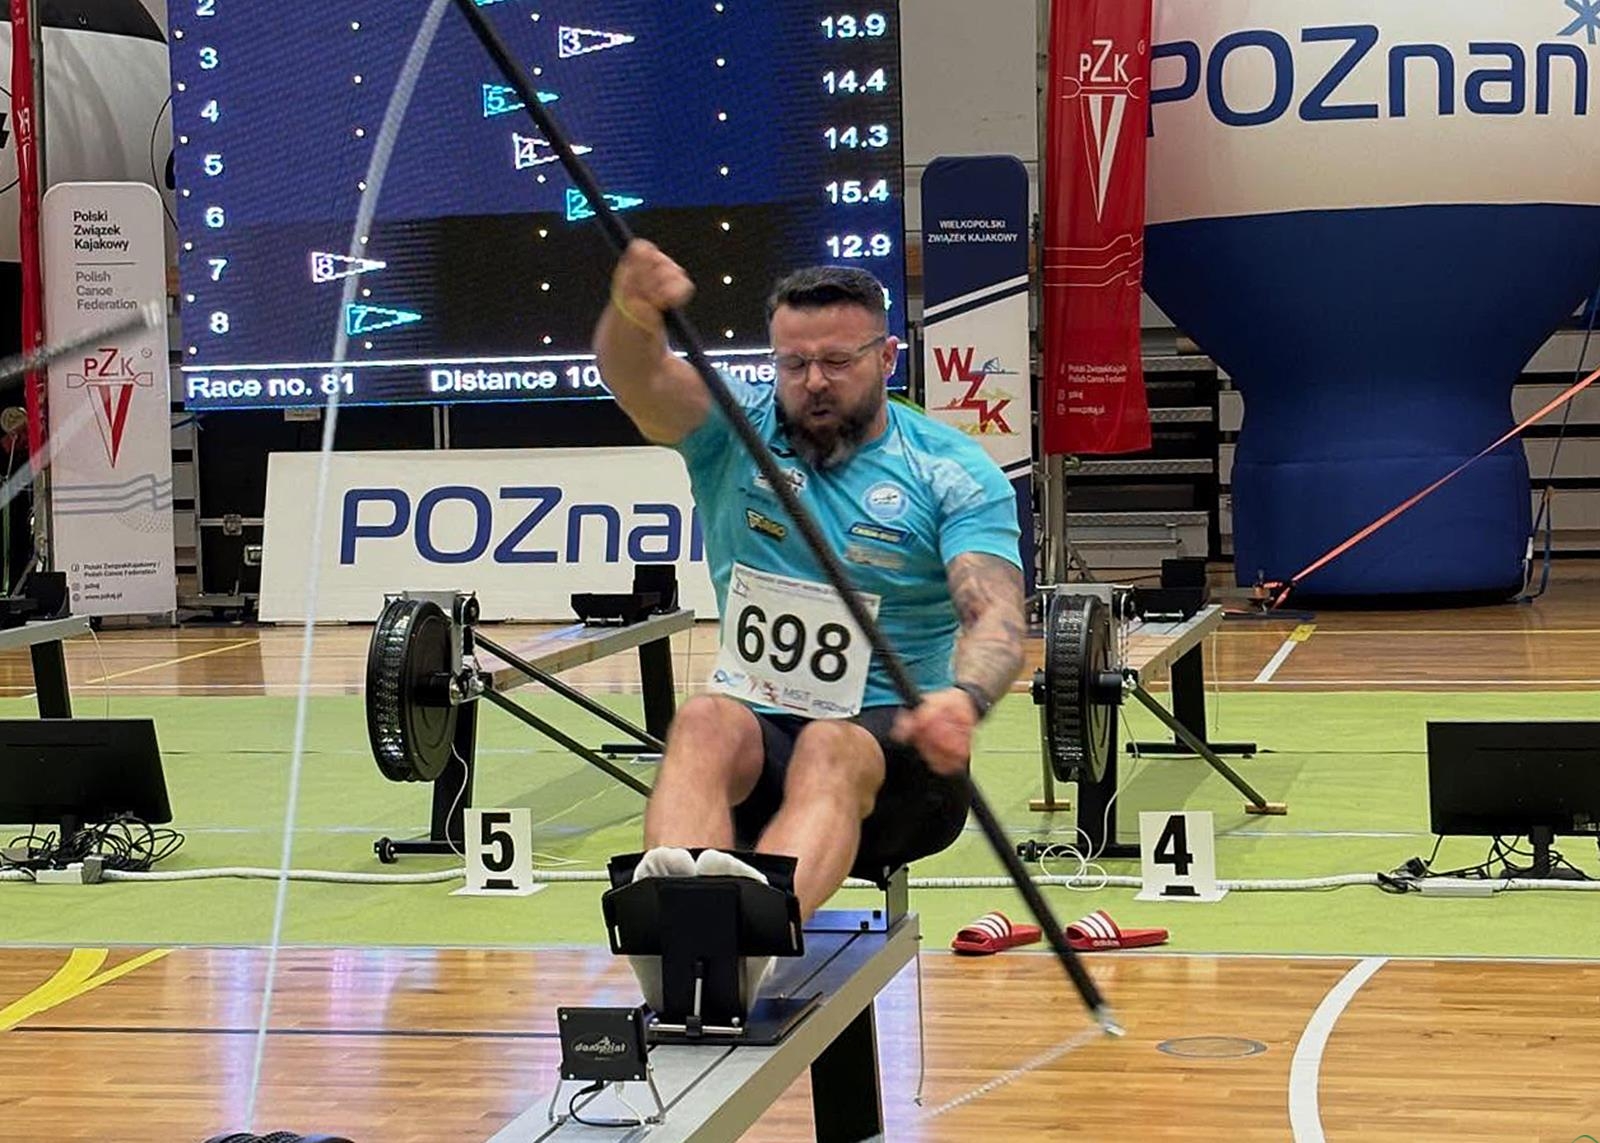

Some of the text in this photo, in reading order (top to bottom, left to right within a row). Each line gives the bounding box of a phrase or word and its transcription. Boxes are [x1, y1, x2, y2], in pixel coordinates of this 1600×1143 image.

[196, 0, 216, 16] 2
[821, 13, 886, 38] 13.9
[200, 47, 218, 69] 3
[1079, 39, 1129, 82] PZK
[823, 68, 887, 94] 14.4
[201, 99, 219, 122] 4
[824, 124, 889, 150] 14.3
[204, 154, 223, 176] 5
[825, 179, 890, 204] 15.4
[73, 211, 108, 222] Polski
[206, 206, 225, 228] 6
[939, 219, 1006, 229] WIELKOPOLSKI
[73, 224, 121, 238] Związek
[967, 232, 1018, 242] KAJAKOWY
[74, 238, 130, 252] Kajakowy
[826, 233, 892, 258] 12.9
[75, 271, 111, 282] Polish
[208, 258, 228, 281] 7
[76, 285, 113, 297] Canoe
[77, 298, 138, 311] Federation
[210, 311, 229, 334] 8
[84, 347, 134, 377] PZK
[188, 376, 262, 399] Race
[268, 379, 312, 397] no.
[321, 372, 354, 395] 81
[430, 369, 557, 392] Distance
[933, 346, 1012, 433] WZK
[736, 604, 851, 682] 698
[481, 812, 516, 873] 5
[1153, 814, 1194, 876] 4
